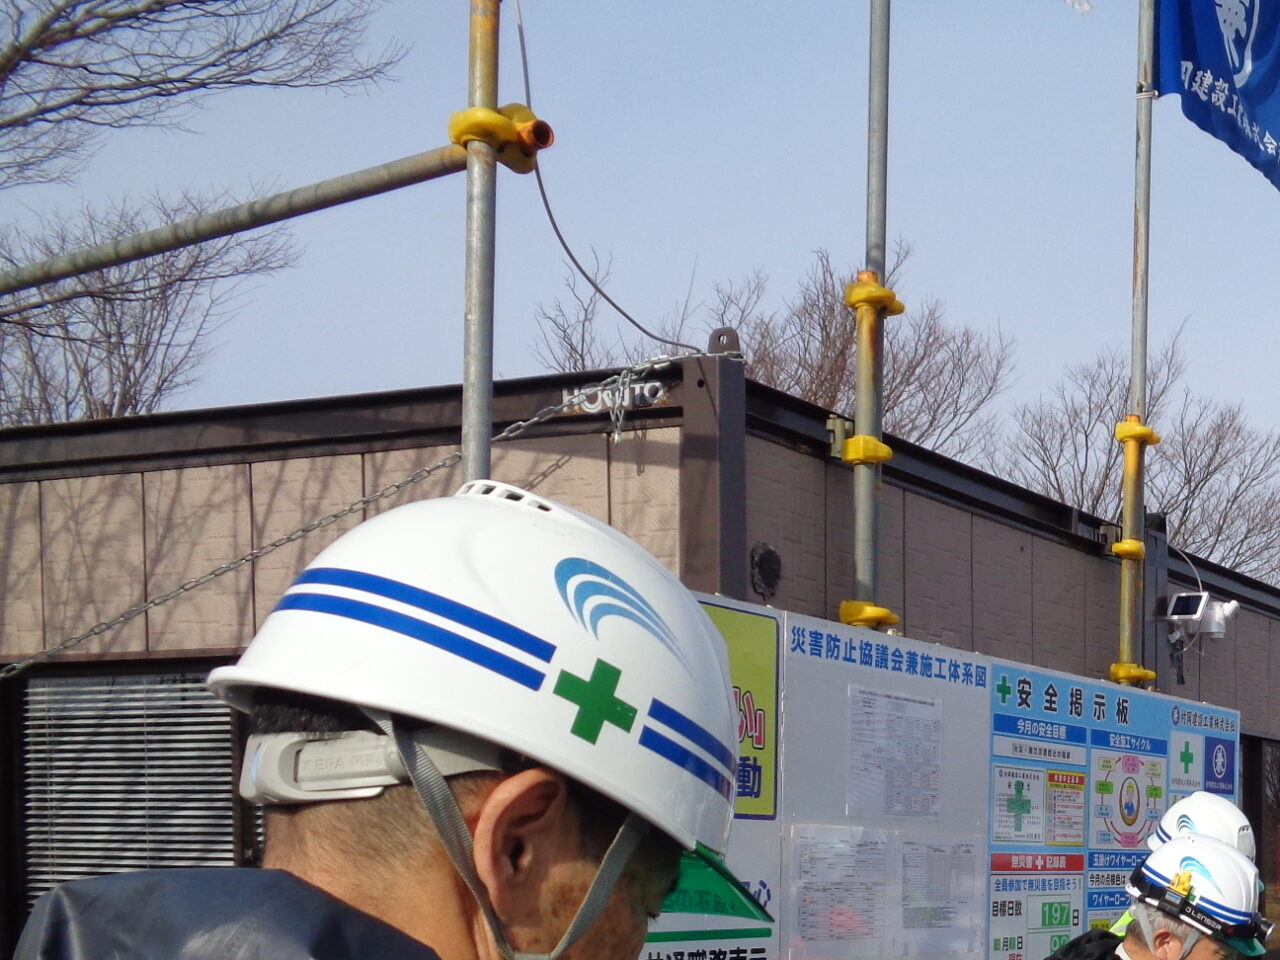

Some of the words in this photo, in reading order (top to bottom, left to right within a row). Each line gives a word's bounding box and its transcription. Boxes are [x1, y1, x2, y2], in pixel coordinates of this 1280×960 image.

[791, 625, 987, 688] 災害防止協議会兼施工体系図
[1017, 678, 1129, 725] 安全掲示板
[992, 900, 1023, 917] 目標日数
[1043, 902, 1071, 926] 197
[1072, 908, 1080, 927] 日
